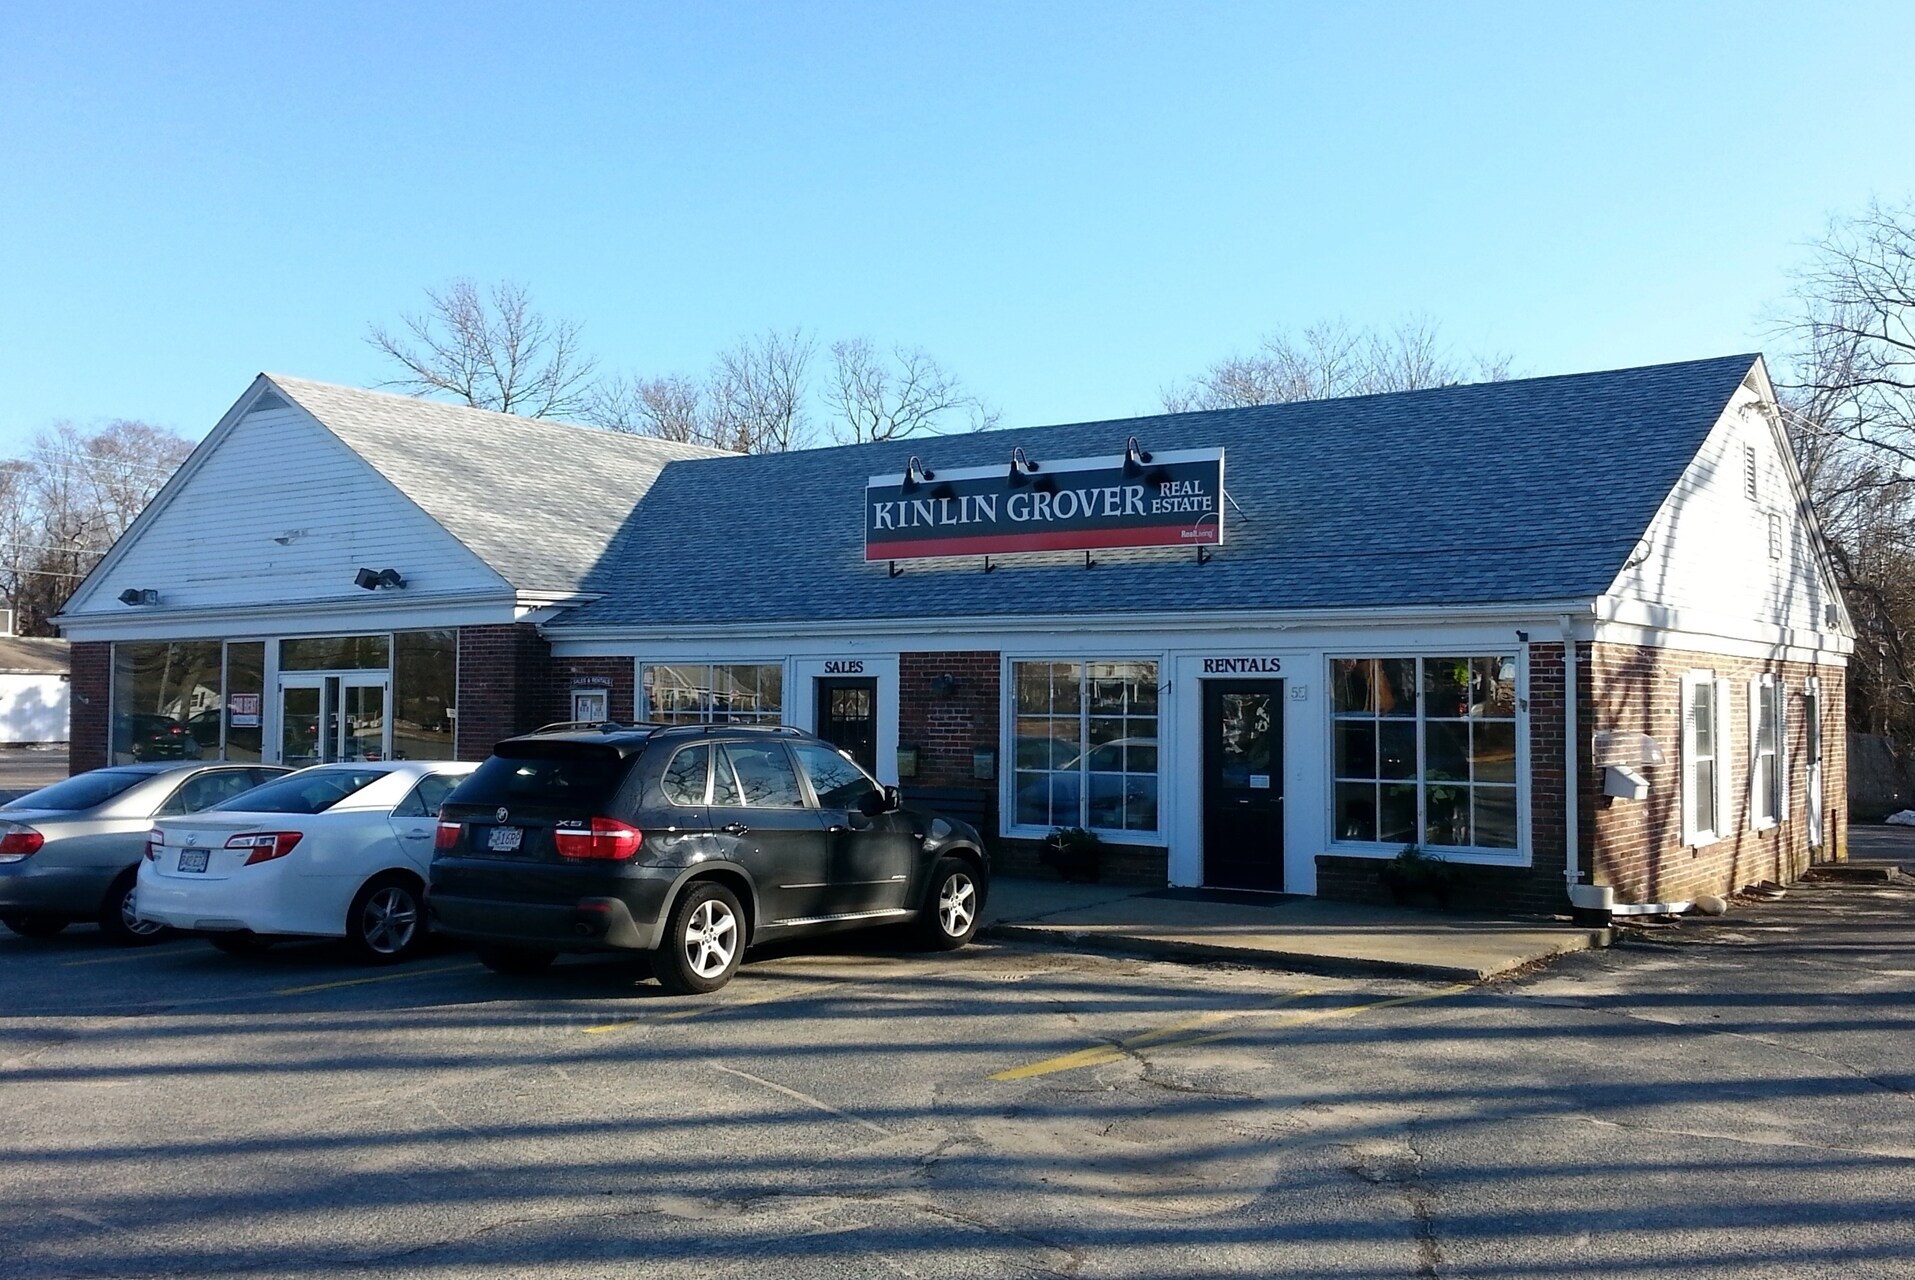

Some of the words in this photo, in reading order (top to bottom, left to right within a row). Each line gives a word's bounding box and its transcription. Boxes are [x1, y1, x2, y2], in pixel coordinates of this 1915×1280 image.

[1160, 480, 1204, 497] REAL
[873, 493, 999, 530] KINLIN
[1006, 484, 1147, 522] GROVER
[1151, 496, 1212, 514] ESTATE
[824, 660, 864, 674] SALES
[1203, 657, 1281, 673] RENTALS
[573, 677, 587, 685] SALES
